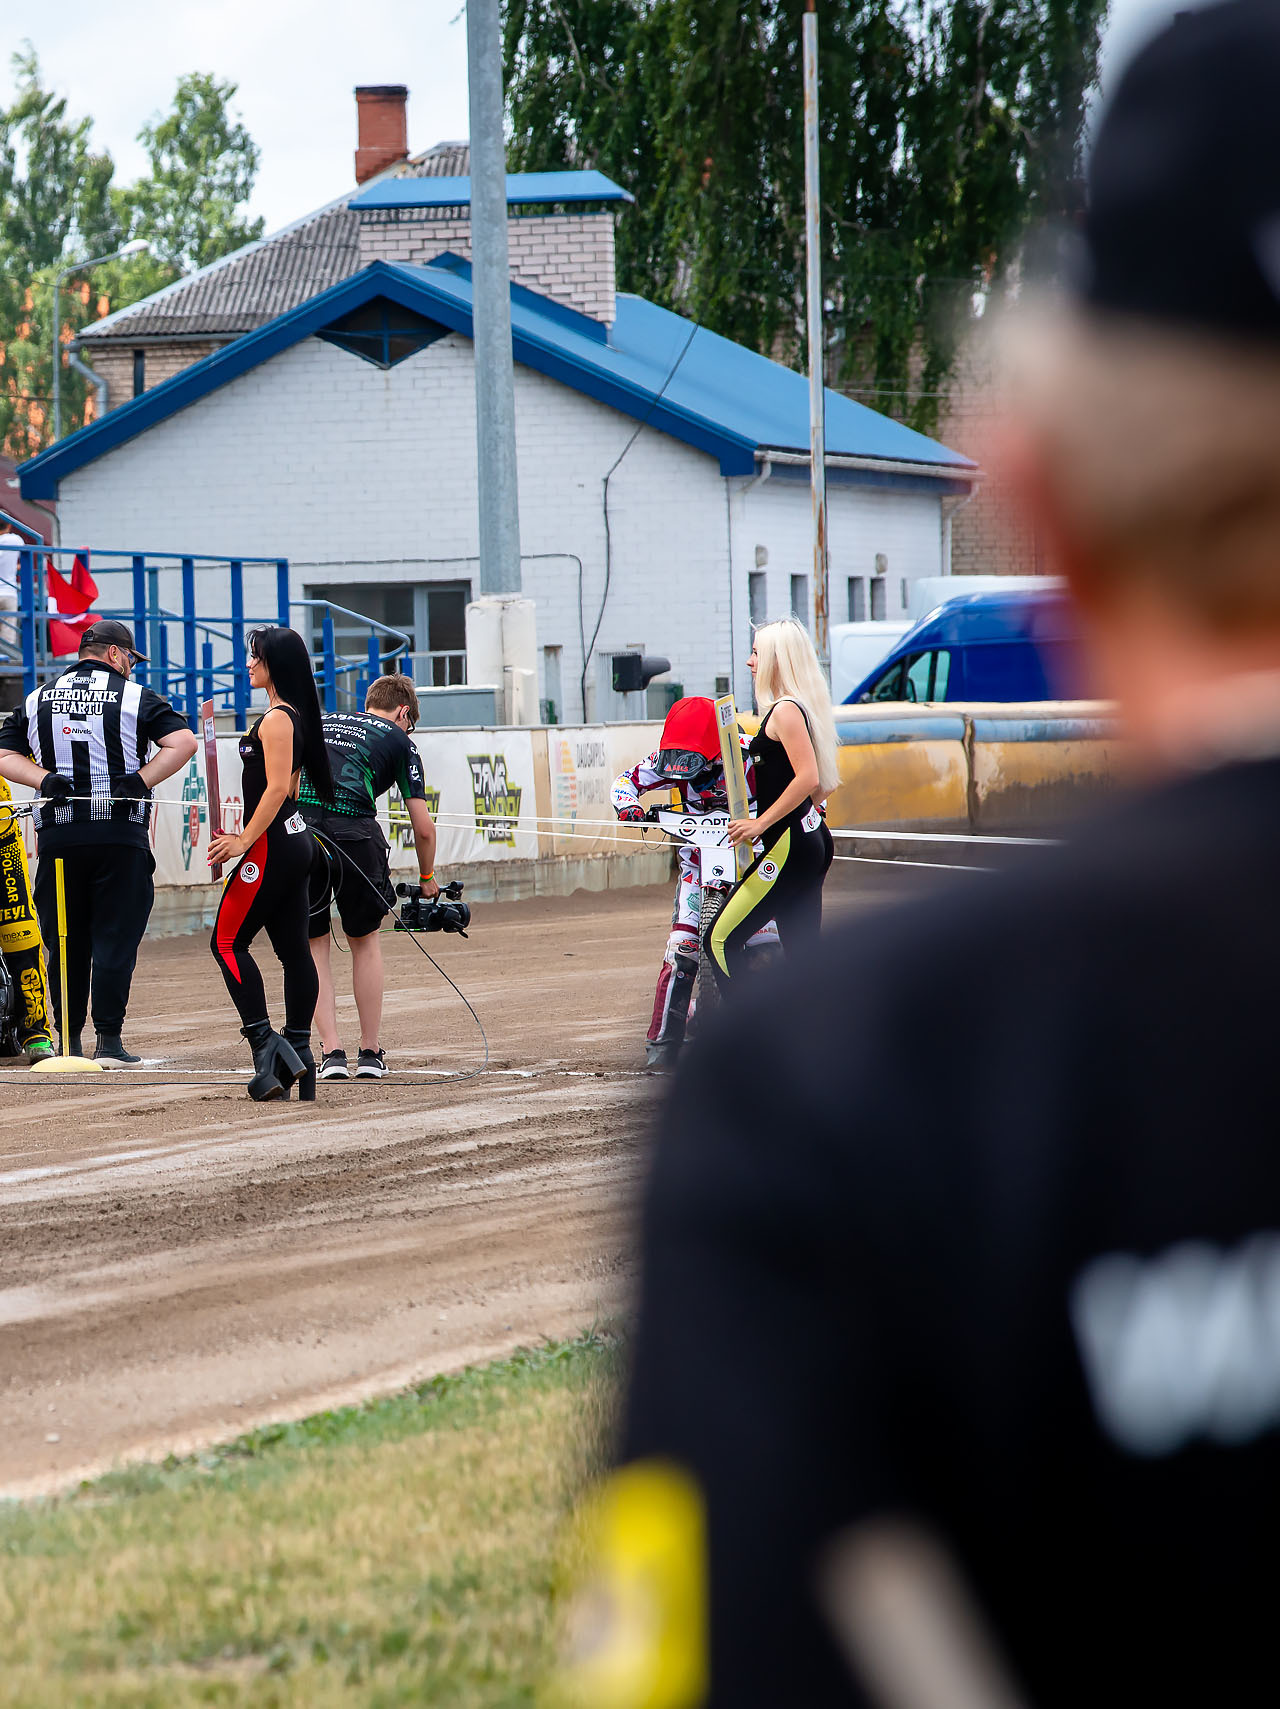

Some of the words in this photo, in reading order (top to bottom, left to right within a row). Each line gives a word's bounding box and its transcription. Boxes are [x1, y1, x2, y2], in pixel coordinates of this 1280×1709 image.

[41, 688, 119, 703] KIEROWNIK
[51, 701, 104, 715] STARTU
[71, 727, 92, 735] Nivels
[0, 851, 20, 904] POL-CAR
